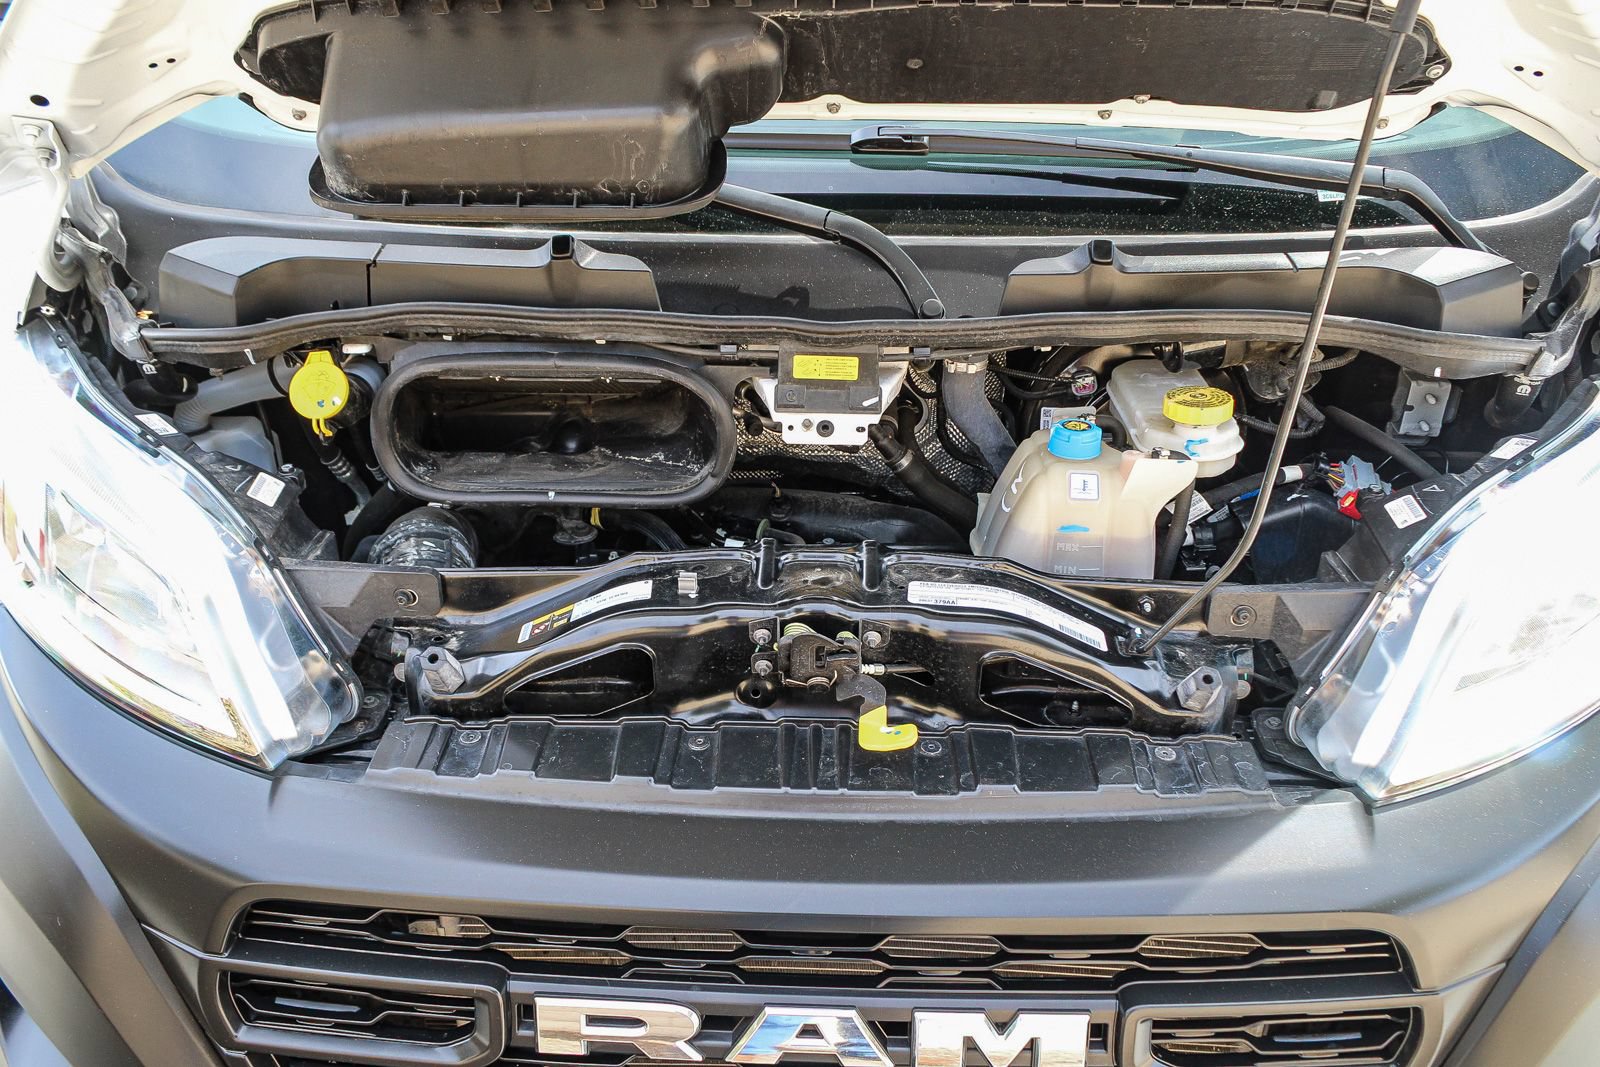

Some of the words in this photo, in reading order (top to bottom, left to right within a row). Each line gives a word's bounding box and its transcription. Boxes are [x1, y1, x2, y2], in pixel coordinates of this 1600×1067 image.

[1056, 542, 1079, 552] MAX
[1054, 564, 1077, 575] MIN
[534, 995, 1091, 1067] RAM
